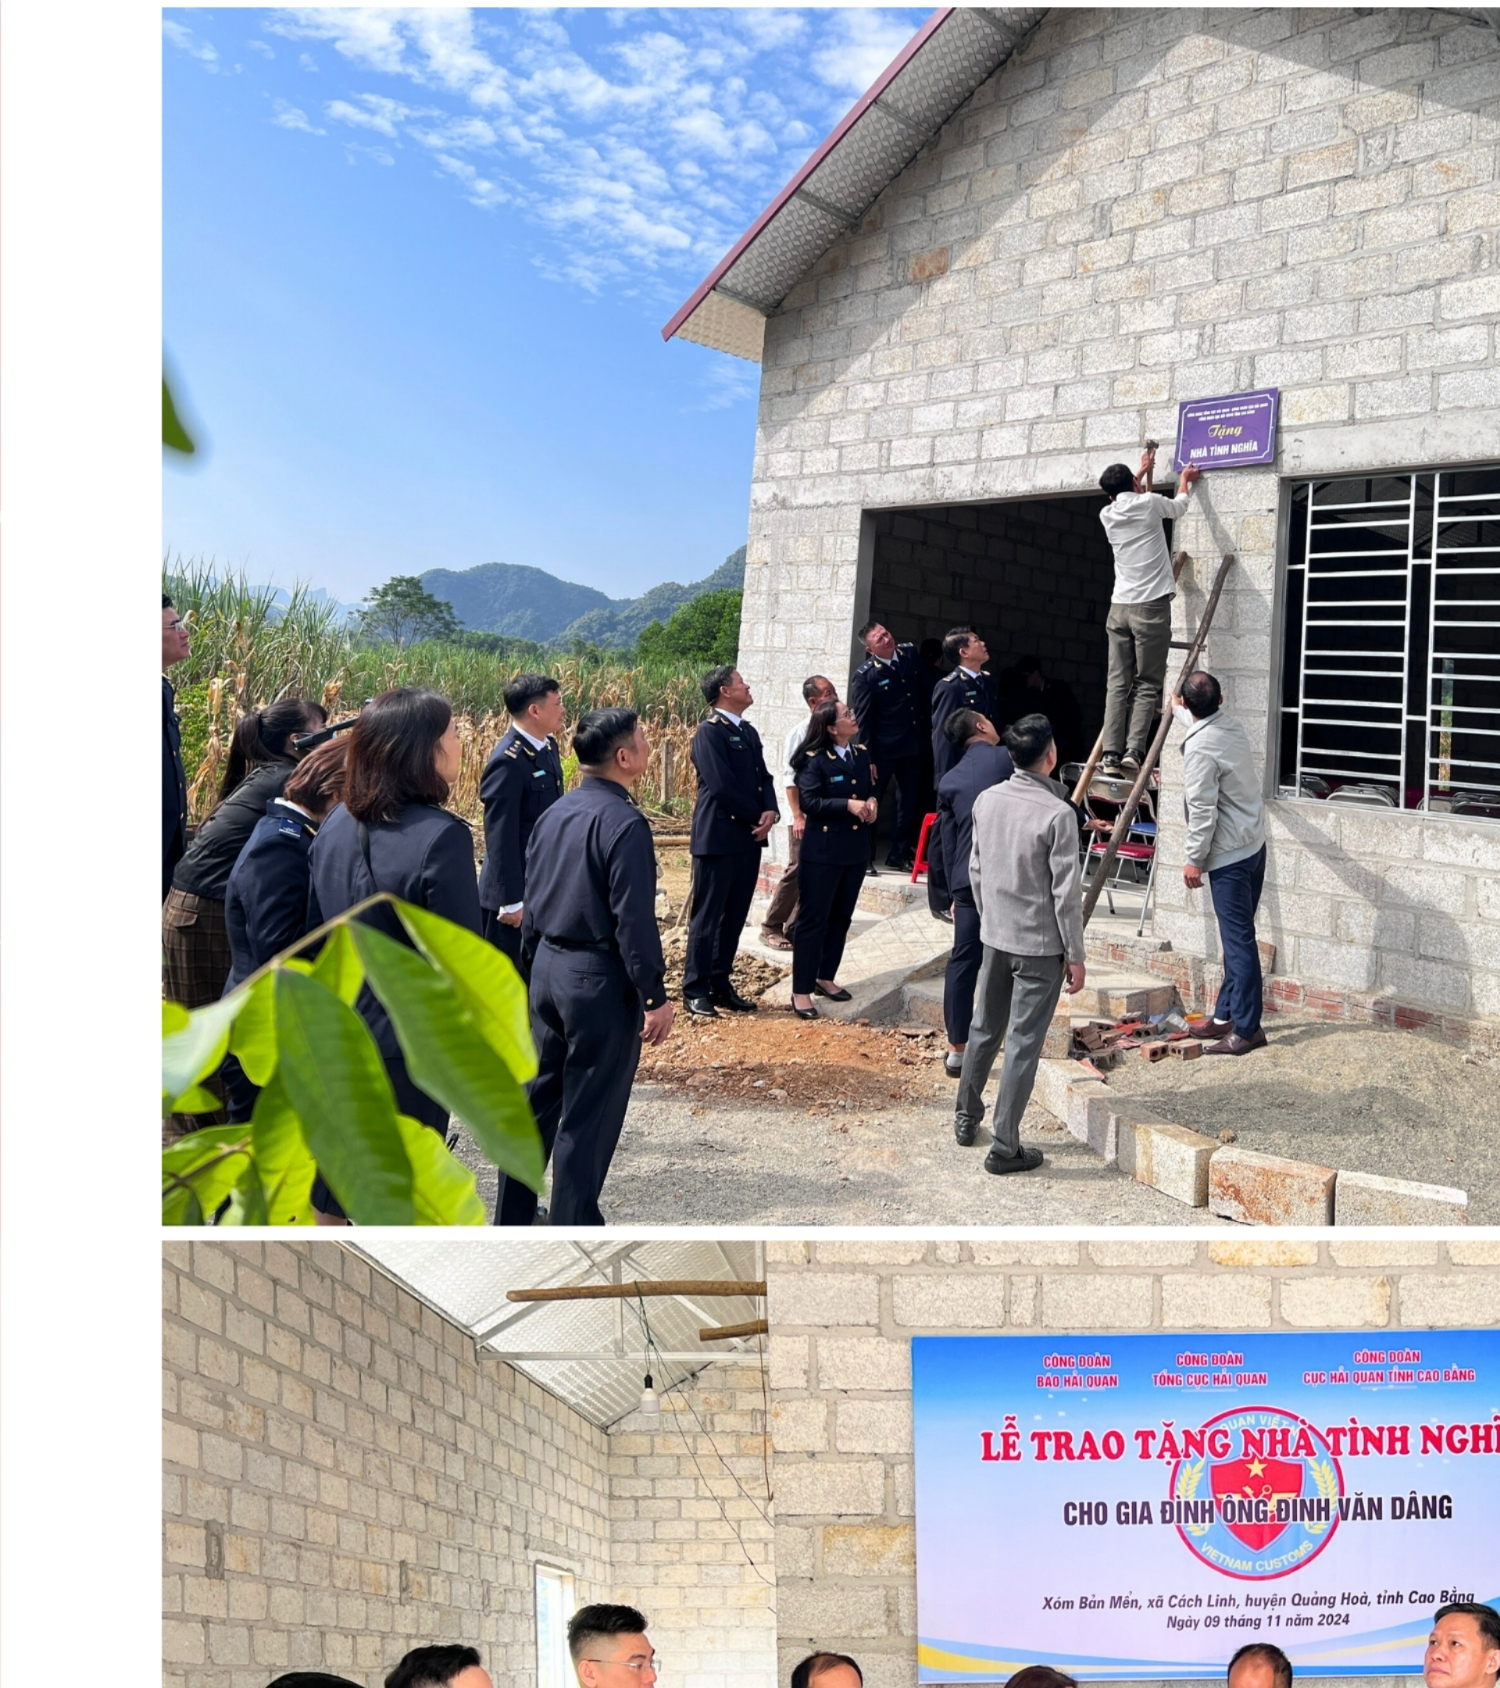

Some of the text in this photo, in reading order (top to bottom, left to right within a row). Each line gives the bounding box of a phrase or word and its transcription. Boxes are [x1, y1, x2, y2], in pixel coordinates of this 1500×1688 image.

[1208, 424, 1243, 439] Tặng
[1190, 440, 1258, 459] NHÀ TÌNH NGHĨA
[1044, 1352, 1111, 1368] CÔNG ĐOÀN
[1176, 1351, 1243, 1366] CÔNG ĐOÀN
[1354, 1349, 1421, 1364] CÔNG ĐOÀN
[1036, 1371, 1118, 1389] BÁO HẢI QUAN
[1152, 1369, 1267, 1389] TỔNG CỤC HẢI QUAN
[1303, 1363, 1475, 1387] CỤC HẢI QUAN TỈNH CAO BẰNG
[980, 1415, 1022, 1462] LỄ
[1030, 1429, 1126, 1461] TRAO
[1134, 1420, 1232, 1466] TẶNG
[1241, 1418, 1317, 1458] NHÀ
[1326, 1417, 1411, 1456] TÌNH
[1063, 1490, 1453, 1526] CHO GIA ĐÌNH ÔNG ĐINH VĂN DÂNG
[1200, 1540, 1314, 1572] VIETNAM CUSTOMS
[1042, 1596, 1074, 1610] Xóm
[1079, 1594, 1105, 1610] Bản
[1147, 1595, 1164, 1609] xã
[1168, 1594, 1202, 1608] Cách
[1207, 1594, 1240, 1609] Linh,
[1245, 1593, 1286, 1611] huyện
[1291, 1591, 1336, 1609] Quảng
[1340, 1591, 1371, 1607] Hoà,
[1376, 1590, 1403, 1605] tỉnh
[1408, 1591, 1435, 1604] Cao
[1166, 1613, 1350, 1631] Ngày 09 tháng 11 năm 2024
